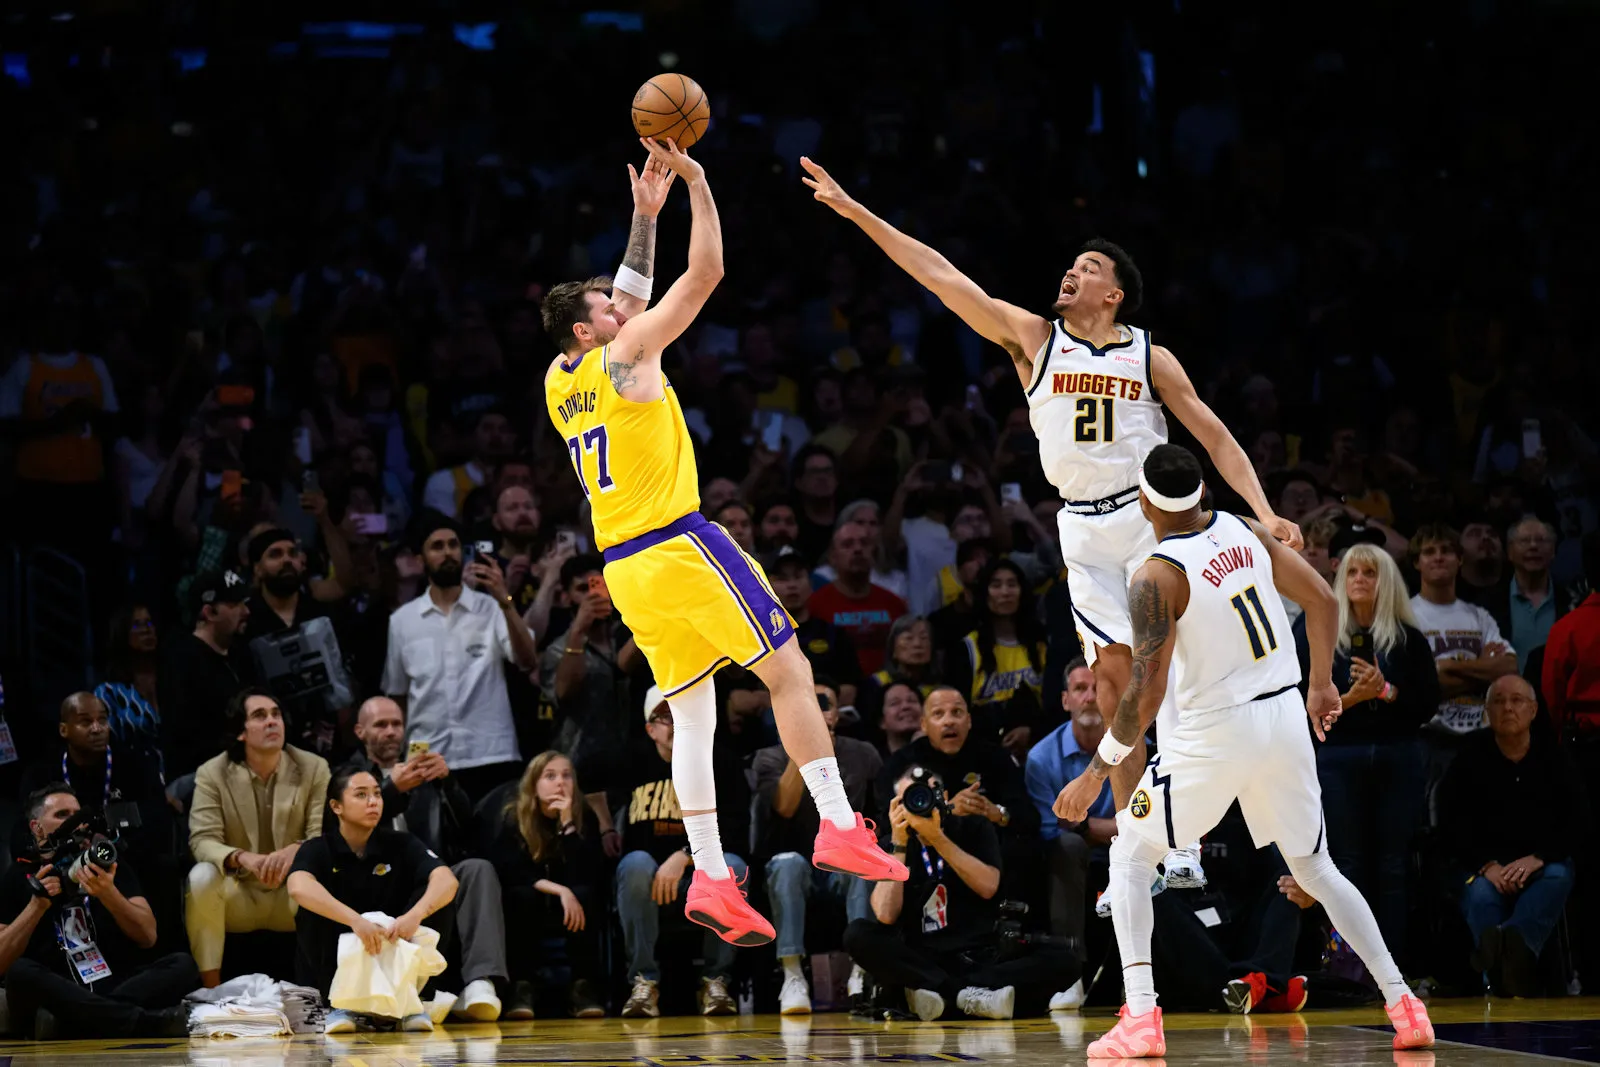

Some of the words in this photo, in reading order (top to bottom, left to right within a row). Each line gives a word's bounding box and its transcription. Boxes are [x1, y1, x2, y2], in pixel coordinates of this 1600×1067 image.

[1052, 373, 1143, 401] NUGGETS
[1074, 397, 1115, 443] 21
[1201, 545, 1254, 588] BROWN
[1230, 584, 1278, 662] 11
